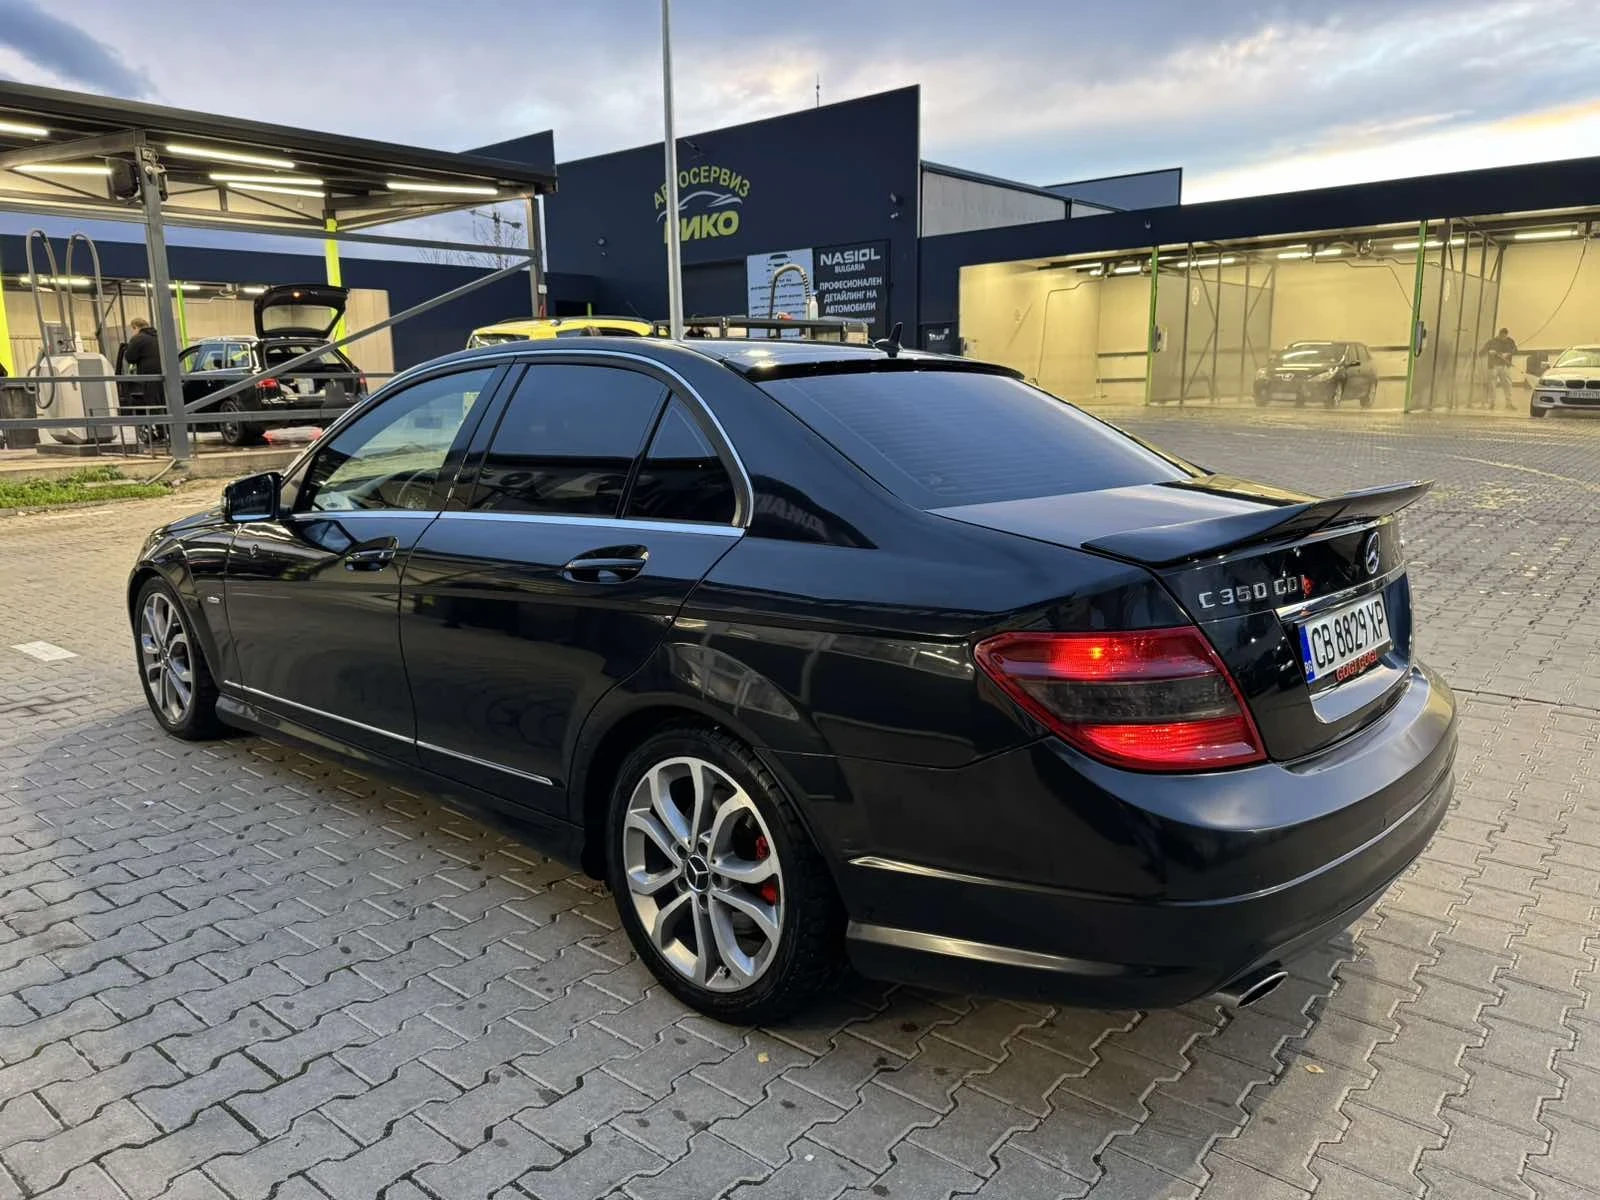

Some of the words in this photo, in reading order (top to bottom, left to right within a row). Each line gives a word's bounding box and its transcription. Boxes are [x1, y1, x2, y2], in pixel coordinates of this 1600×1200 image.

[654, 165, 750, 210] АВОСЕРВИЗ
[820, 248, 880, 266] NASIOL
[834, 263, 865, 273] BULGARIA
[819, 277, 882, 290] ПРОФЕСИОНАЛЕН
[824, 291, 864, 304] ДЕТАЙЛИНГ
[866, 290, 877, 299] НА
[825, 302, 876, 314] АВТОМОБИЛИ
[1199, 591, 1216, 609] C
[1219, 582, 1268, 605] 350
[1311, 624, 1335, 669] CB
[1334, 608, 1368, 658] 8829
[1366, 600, 1384, 642] XP
